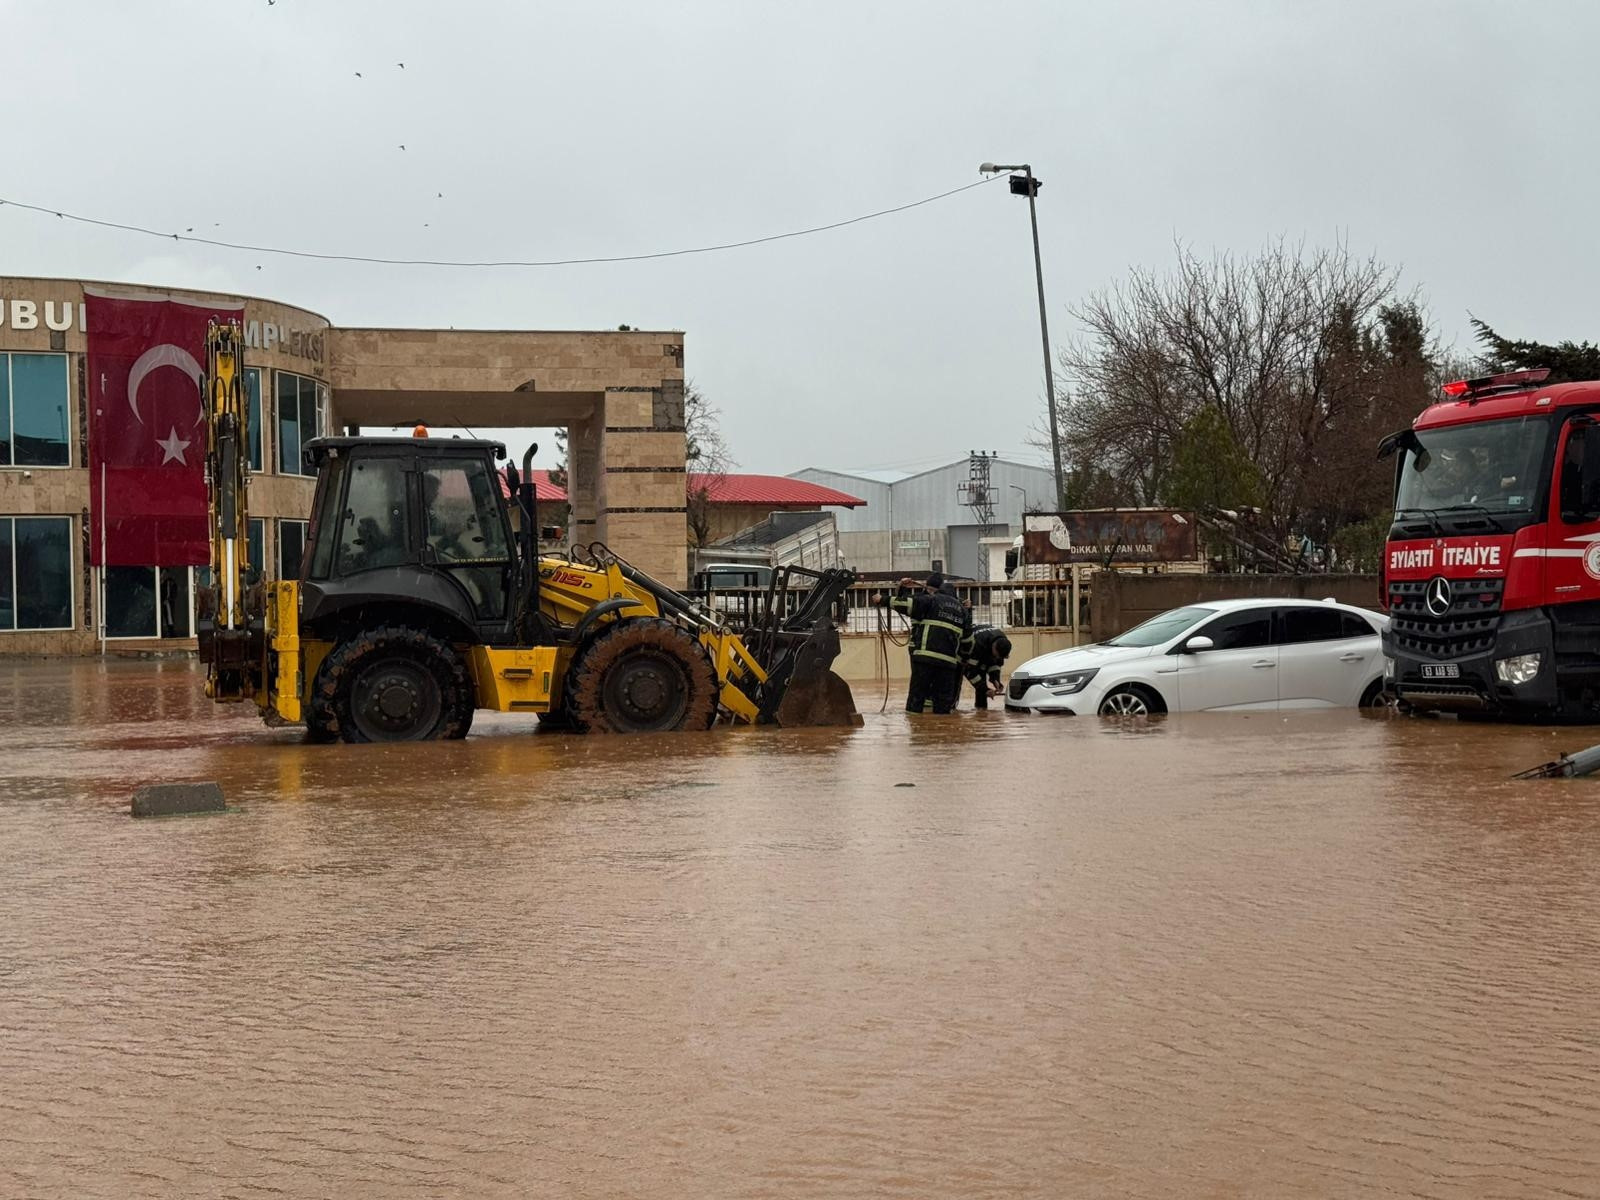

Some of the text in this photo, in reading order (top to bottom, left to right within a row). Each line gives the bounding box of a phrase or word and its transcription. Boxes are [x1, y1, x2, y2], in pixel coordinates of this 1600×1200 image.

[1070, 545, 1099, 554] DİKKA
[1135, 543, 1153, 553] VAR
[1441, 541, 1501, 566] İTFAİYE
